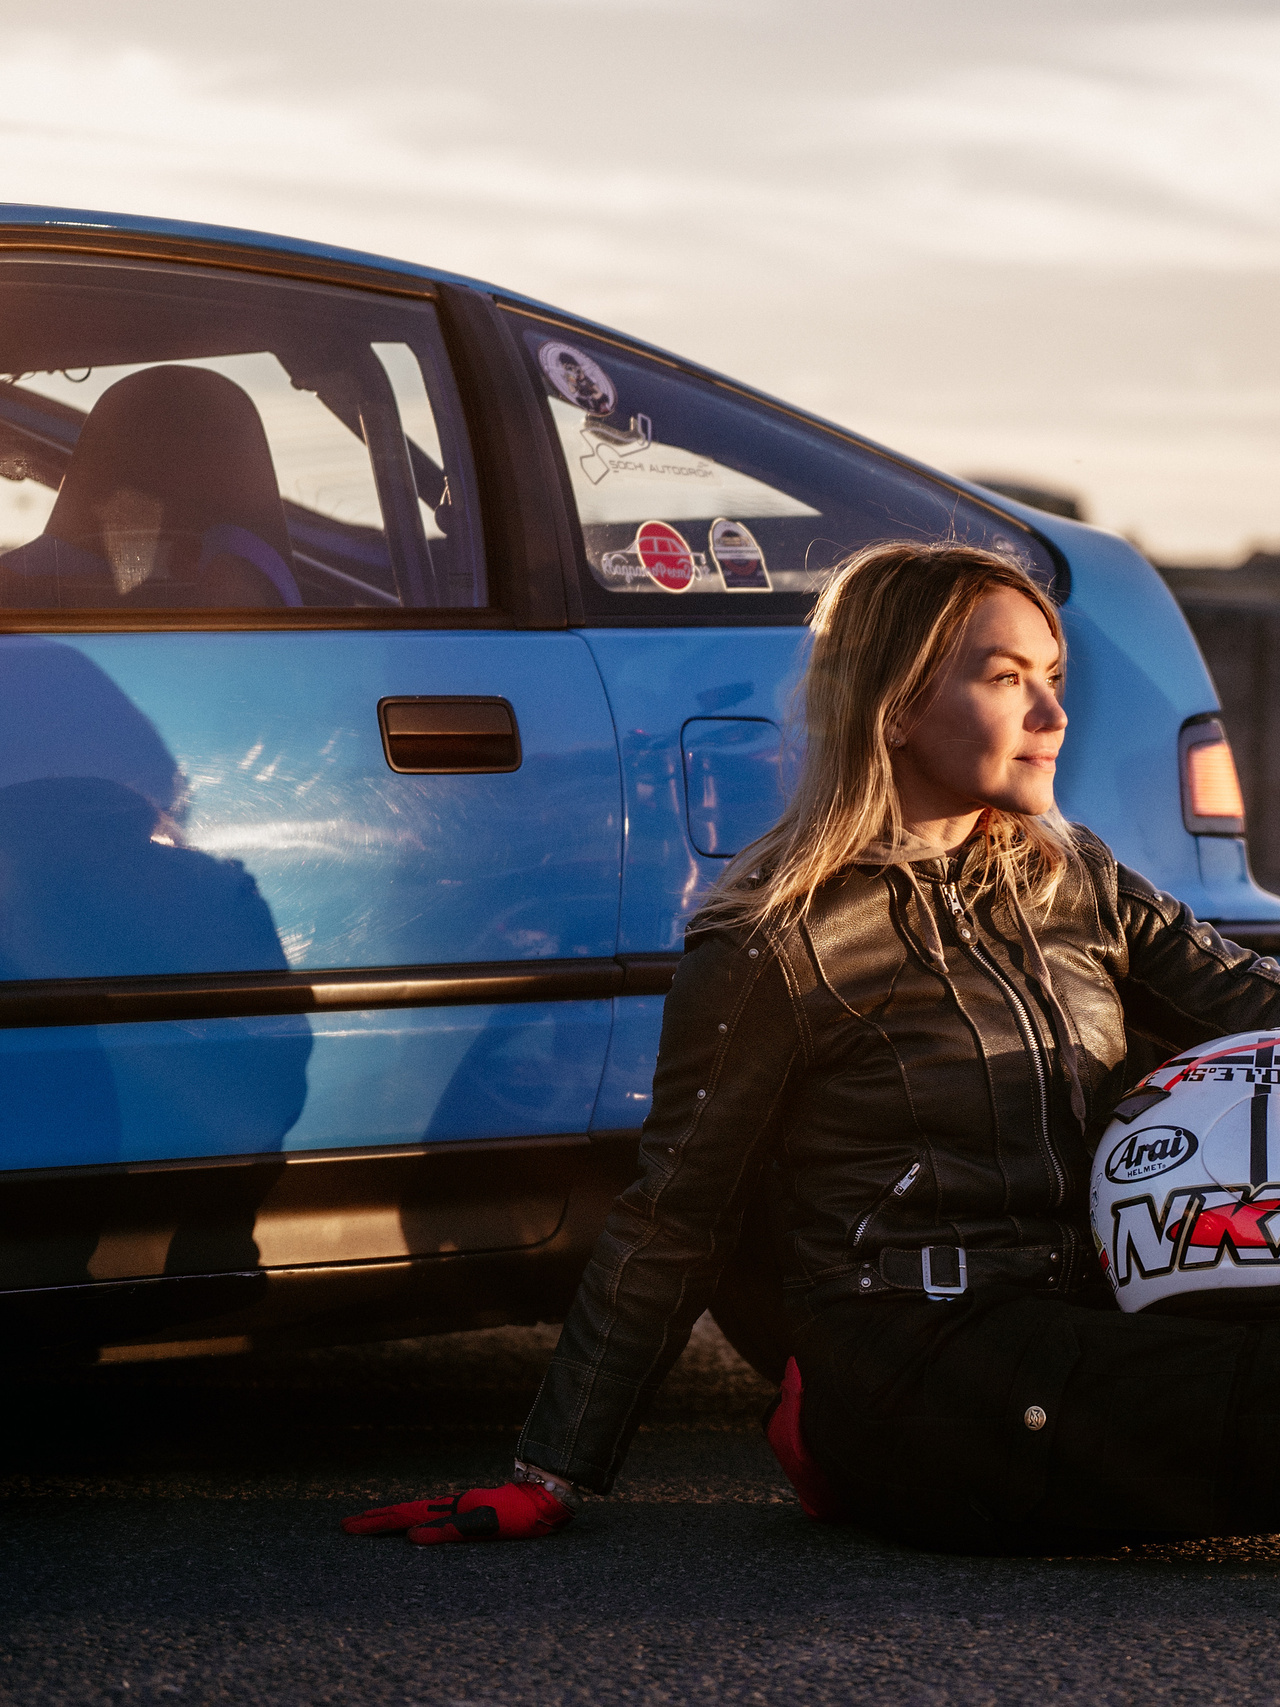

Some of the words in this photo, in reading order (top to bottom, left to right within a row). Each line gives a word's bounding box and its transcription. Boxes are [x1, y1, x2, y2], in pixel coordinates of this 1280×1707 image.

[609, 460, 645, 472] SOCHI
[649, 464, 714, 478] AUTODROM
[1109, 1129, 1184, 1176] Arai
